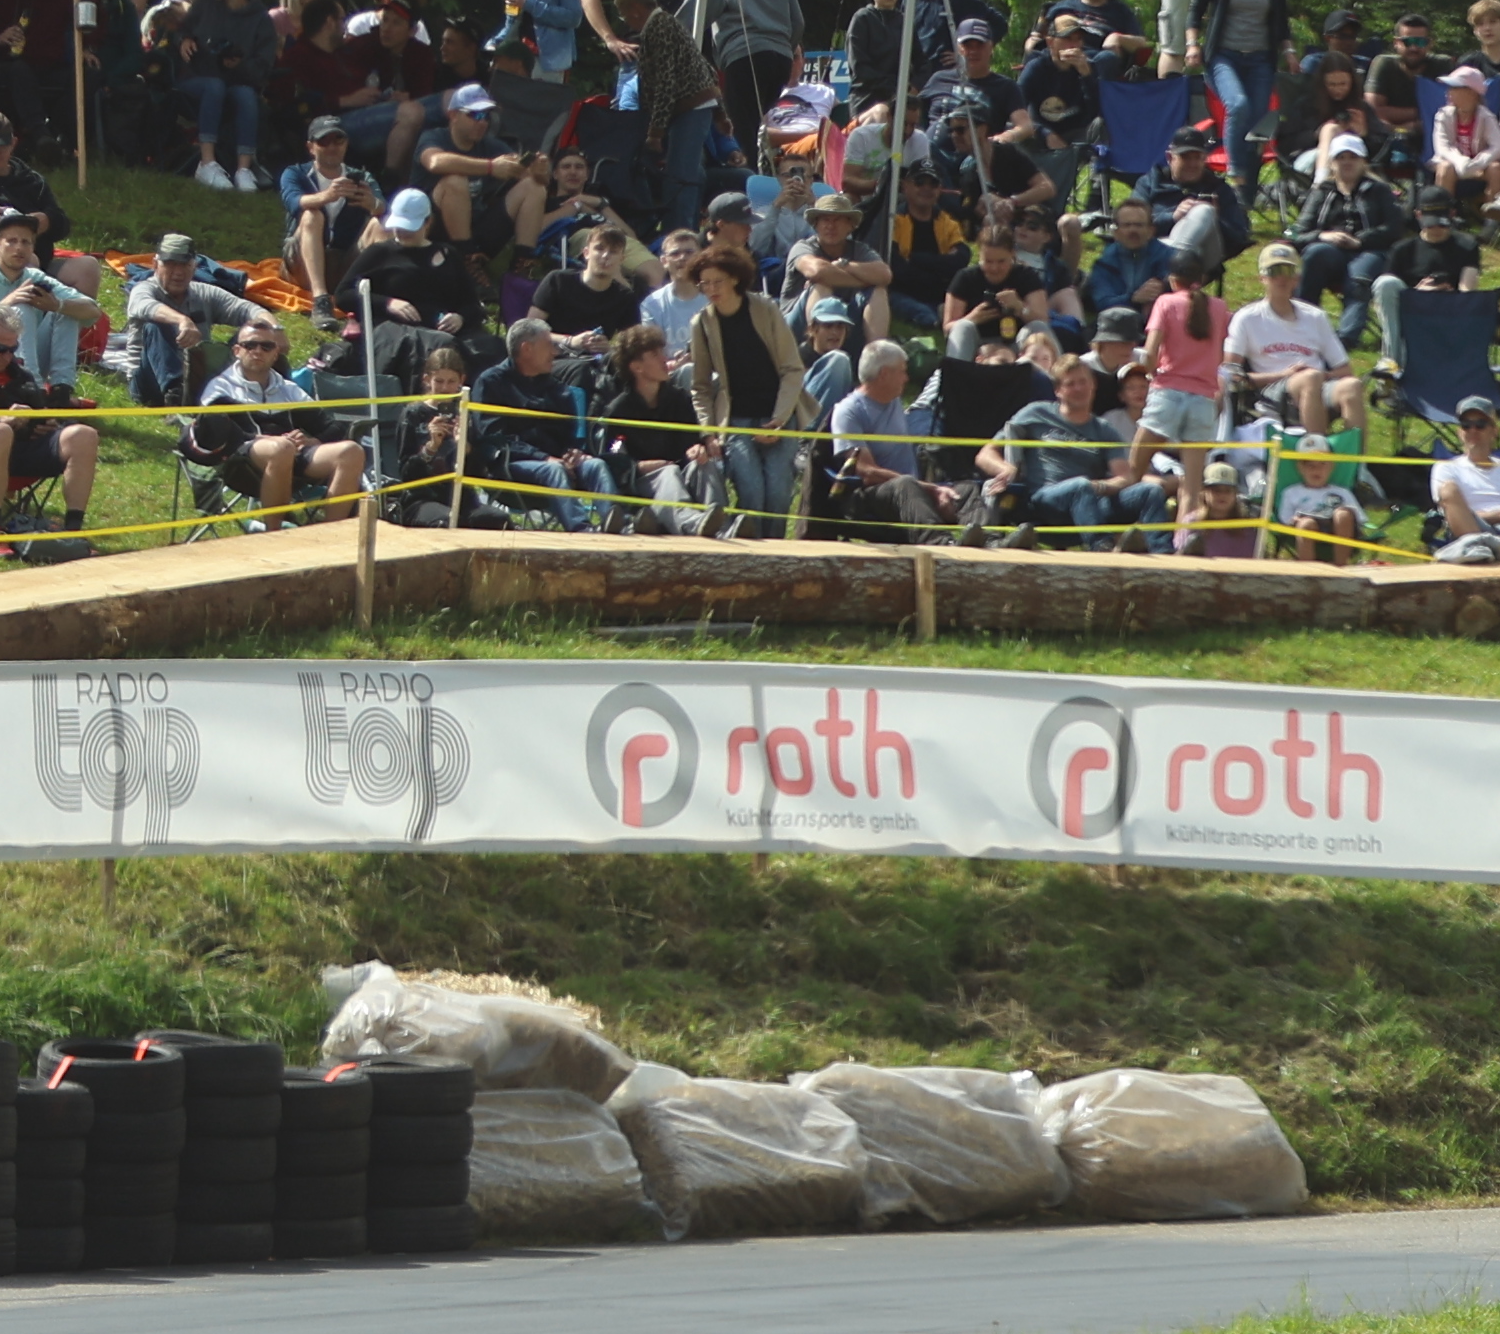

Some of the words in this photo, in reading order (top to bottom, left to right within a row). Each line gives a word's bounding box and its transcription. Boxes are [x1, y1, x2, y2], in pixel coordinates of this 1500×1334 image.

[76, 672, 169, 706] RADIO
[340, 671, 434, 704] RADIO
[726, 687, 917, 800] roth
[1167, 708, 1383, 824] roth
[726, 807, 866, 833] kühltransporte
[1166, 824, 1320, 854] kühltransporte
[1325, 831, 1384, 856] gmbh
